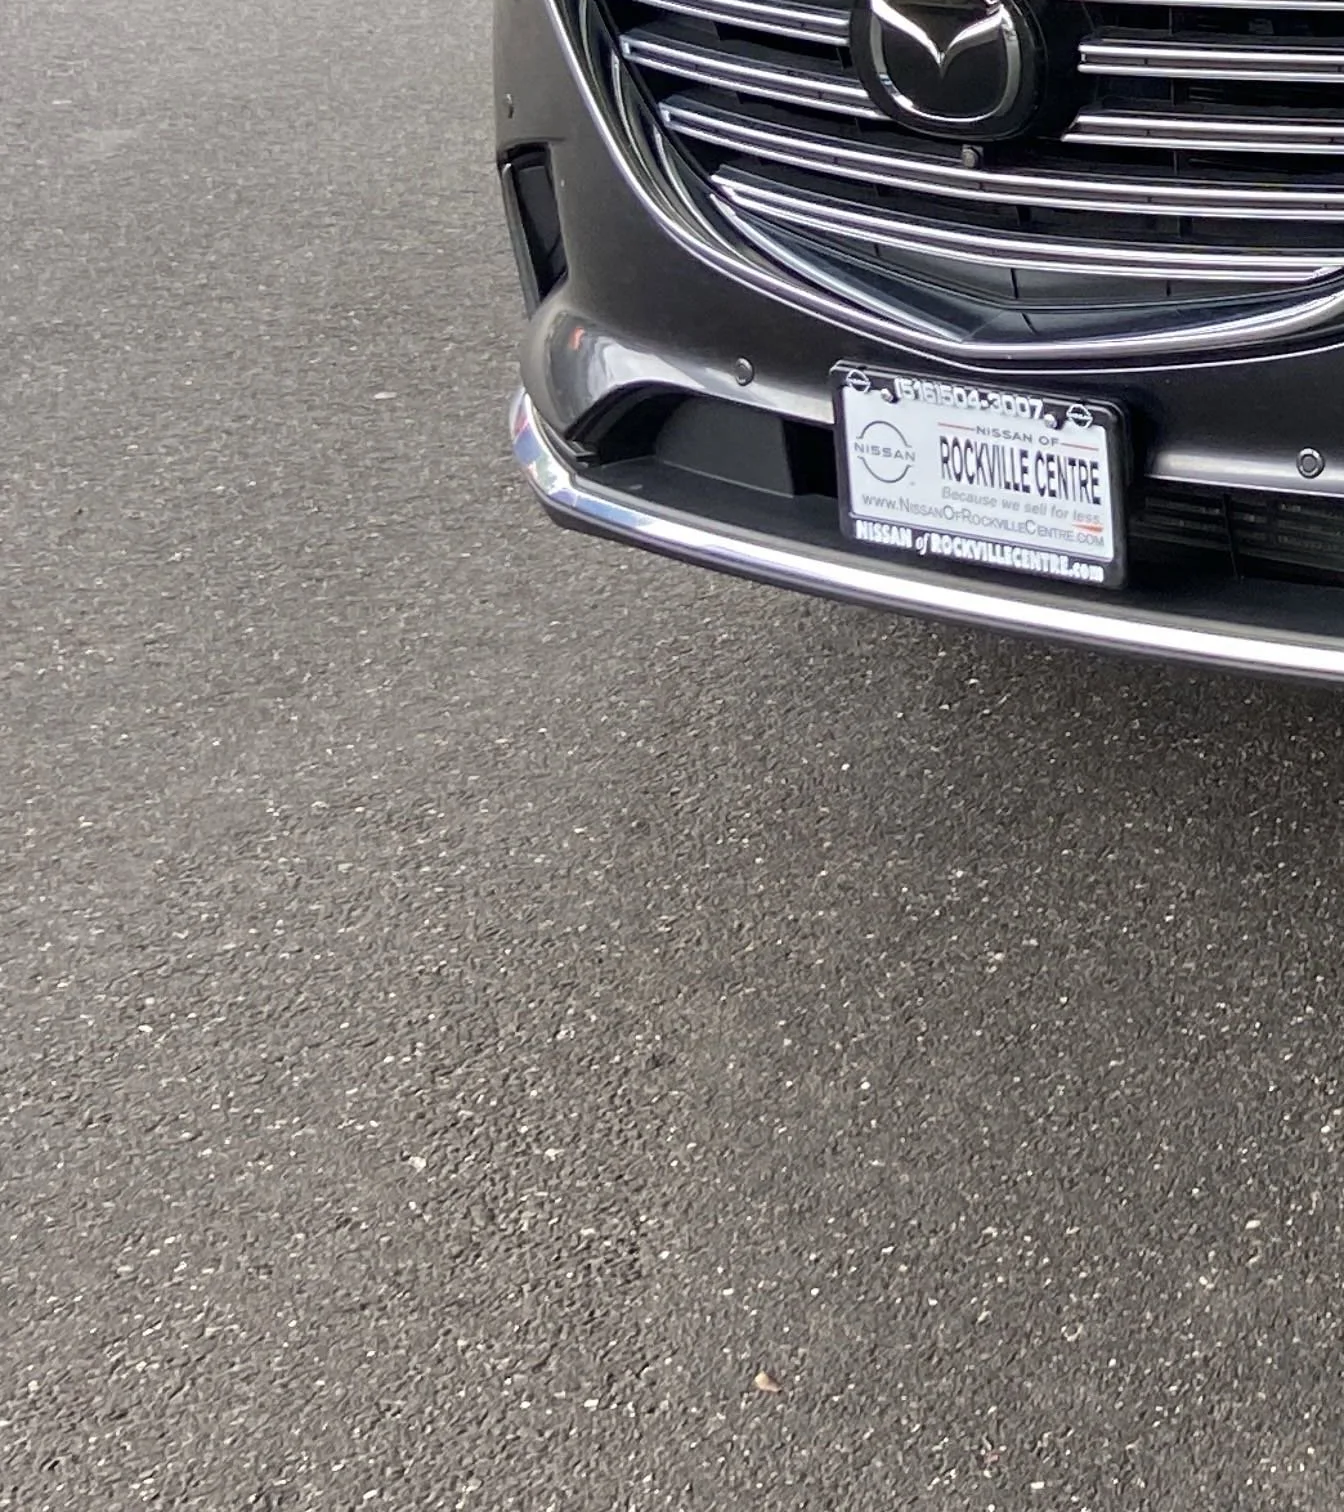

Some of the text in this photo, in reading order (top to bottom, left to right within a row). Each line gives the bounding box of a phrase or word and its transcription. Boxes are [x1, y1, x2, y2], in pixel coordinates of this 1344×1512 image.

[854, 442, 916, 462] NISSAN
[976, 425, 1060, 447] NISSAN OF
[940, 435, 1101, 505] ROCKVILLE CENTRE
[941, 486, 998, 508] Because
[1001, 497, 1021, 512] we
[1023, 501, 1048, 517] sell
[1050, 504, 1070, 520] for
[855, 519, 913, 549] NISSAN
[915, 532, 931, 556] of
